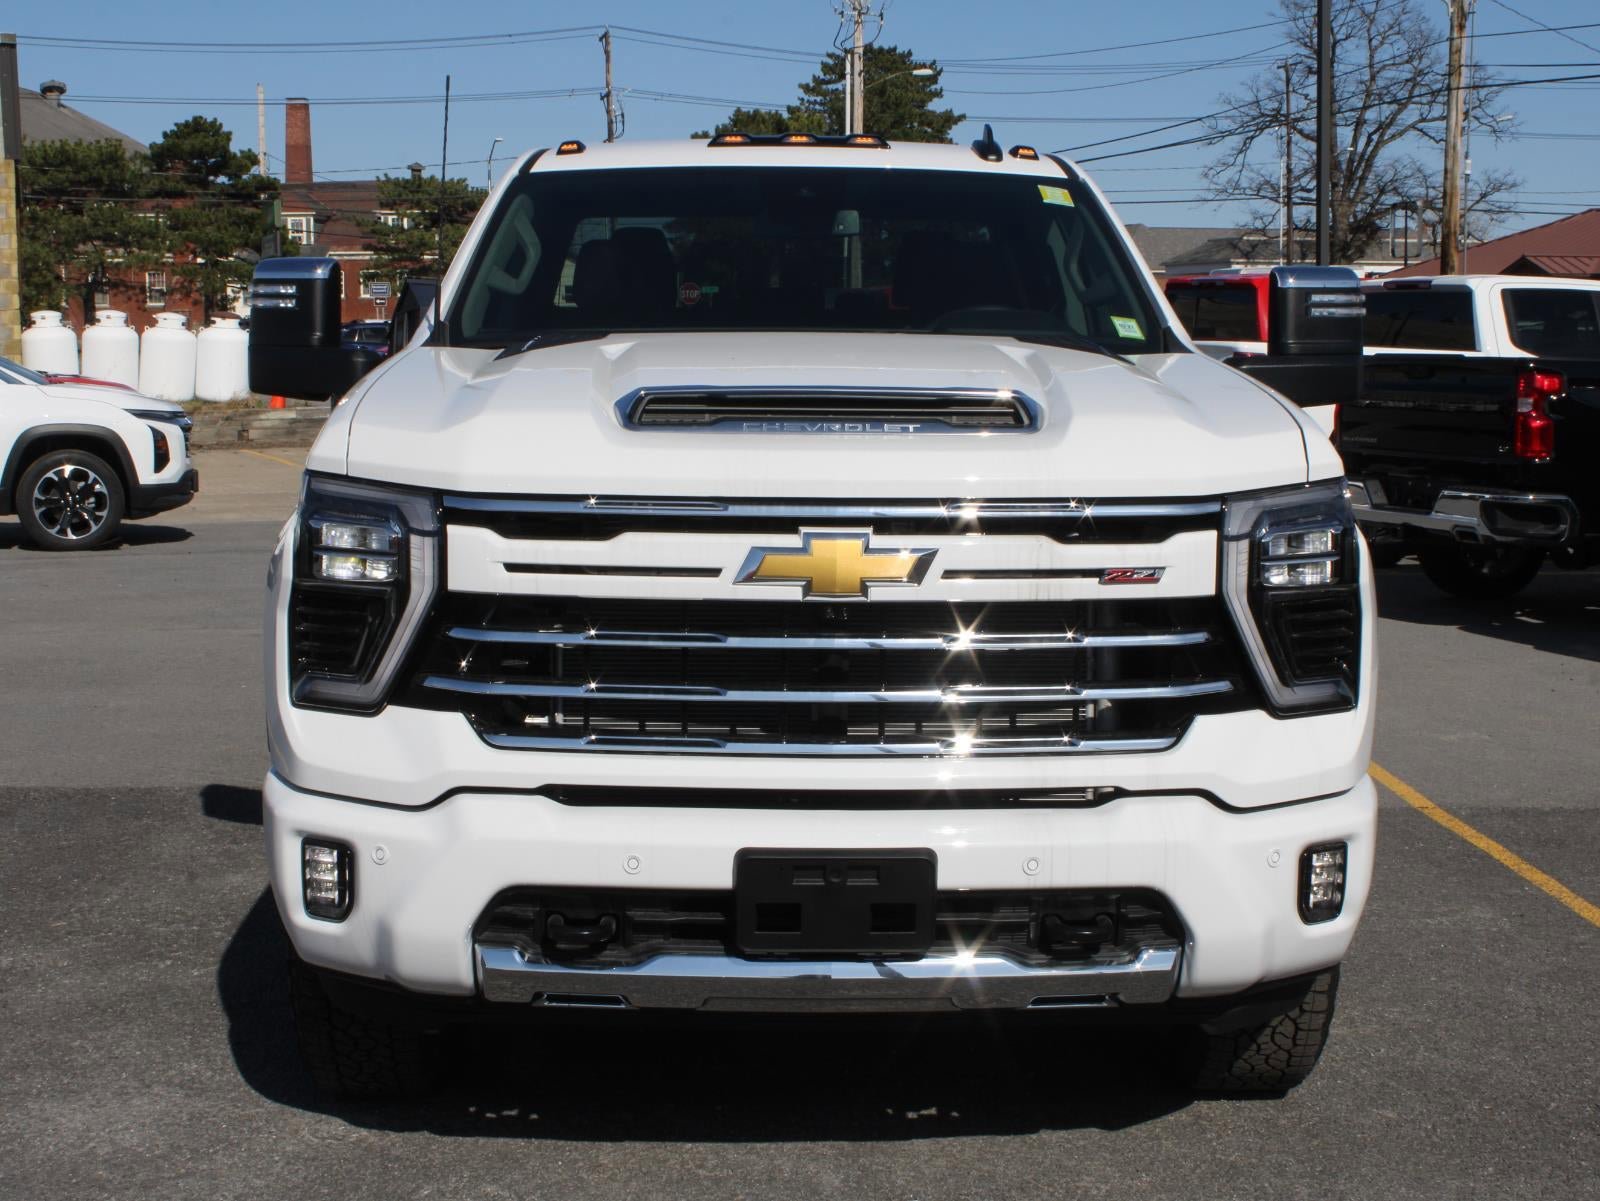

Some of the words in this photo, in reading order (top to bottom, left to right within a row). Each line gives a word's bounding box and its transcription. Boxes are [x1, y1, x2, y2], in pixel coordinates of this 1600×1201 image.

[680, 289, 700, 298] STOP
[742, 422, 921, 433] CHEVROLET
[1102, 567, 1164, 583] Z71
